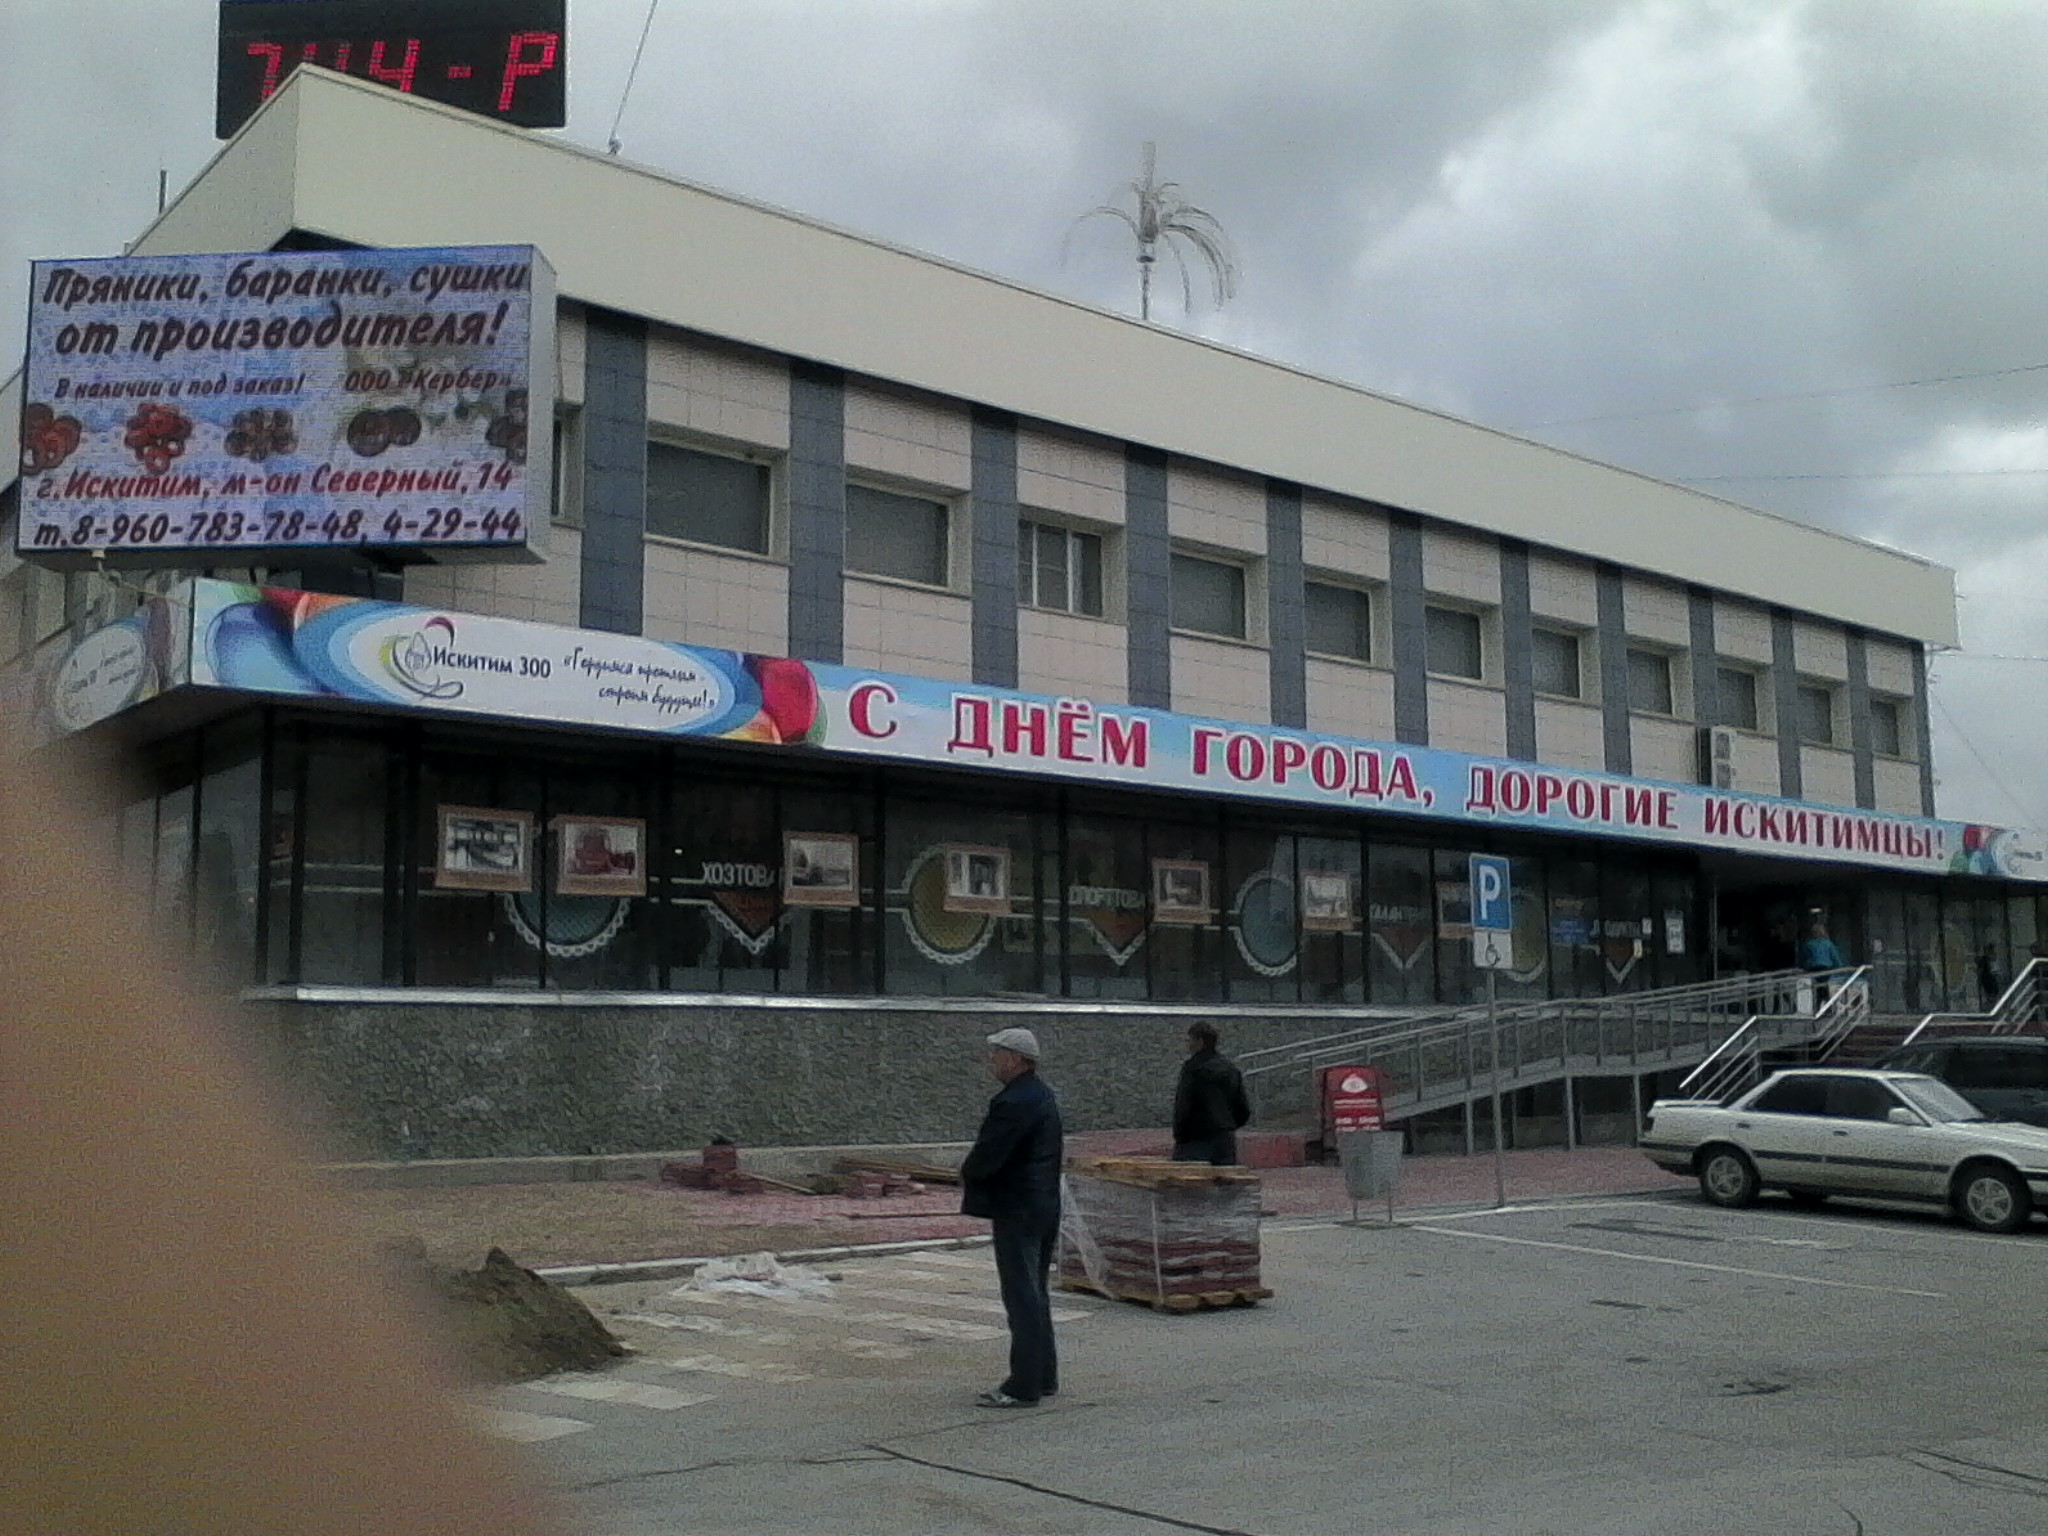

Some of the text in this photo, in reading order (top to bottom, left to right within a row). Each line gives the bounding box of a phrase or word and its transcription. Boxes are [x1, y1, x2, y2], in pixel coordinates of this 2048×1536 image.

[43, 259, 531, 311] Пряники, баранки, сушки
[56, 301, 509, 361] от производителя!
[75, 383, 163, 399] наличии
[168, 384, 182, 396] и
[187, 373, 227, 395] под
[233, 373, 306, 396] заказ!
[345, 370, 391, 391] ООО
[65, 468, 211, 499] Искитим,
[221, 473, 301, 496] м-он
[312, 461, 468, 497] Северный,
[383, 507, 521, 541] 4-29-44
[433, 645, 551, 678] Искитим 300
[848, 685, 1434, 808] С ДНЁМ ГОРОДА,
[1466, 766, 1945, 859] ДОРОГИЕ ИСКИТИМЦЫ!
[1478, 865, 1500, 920] P
